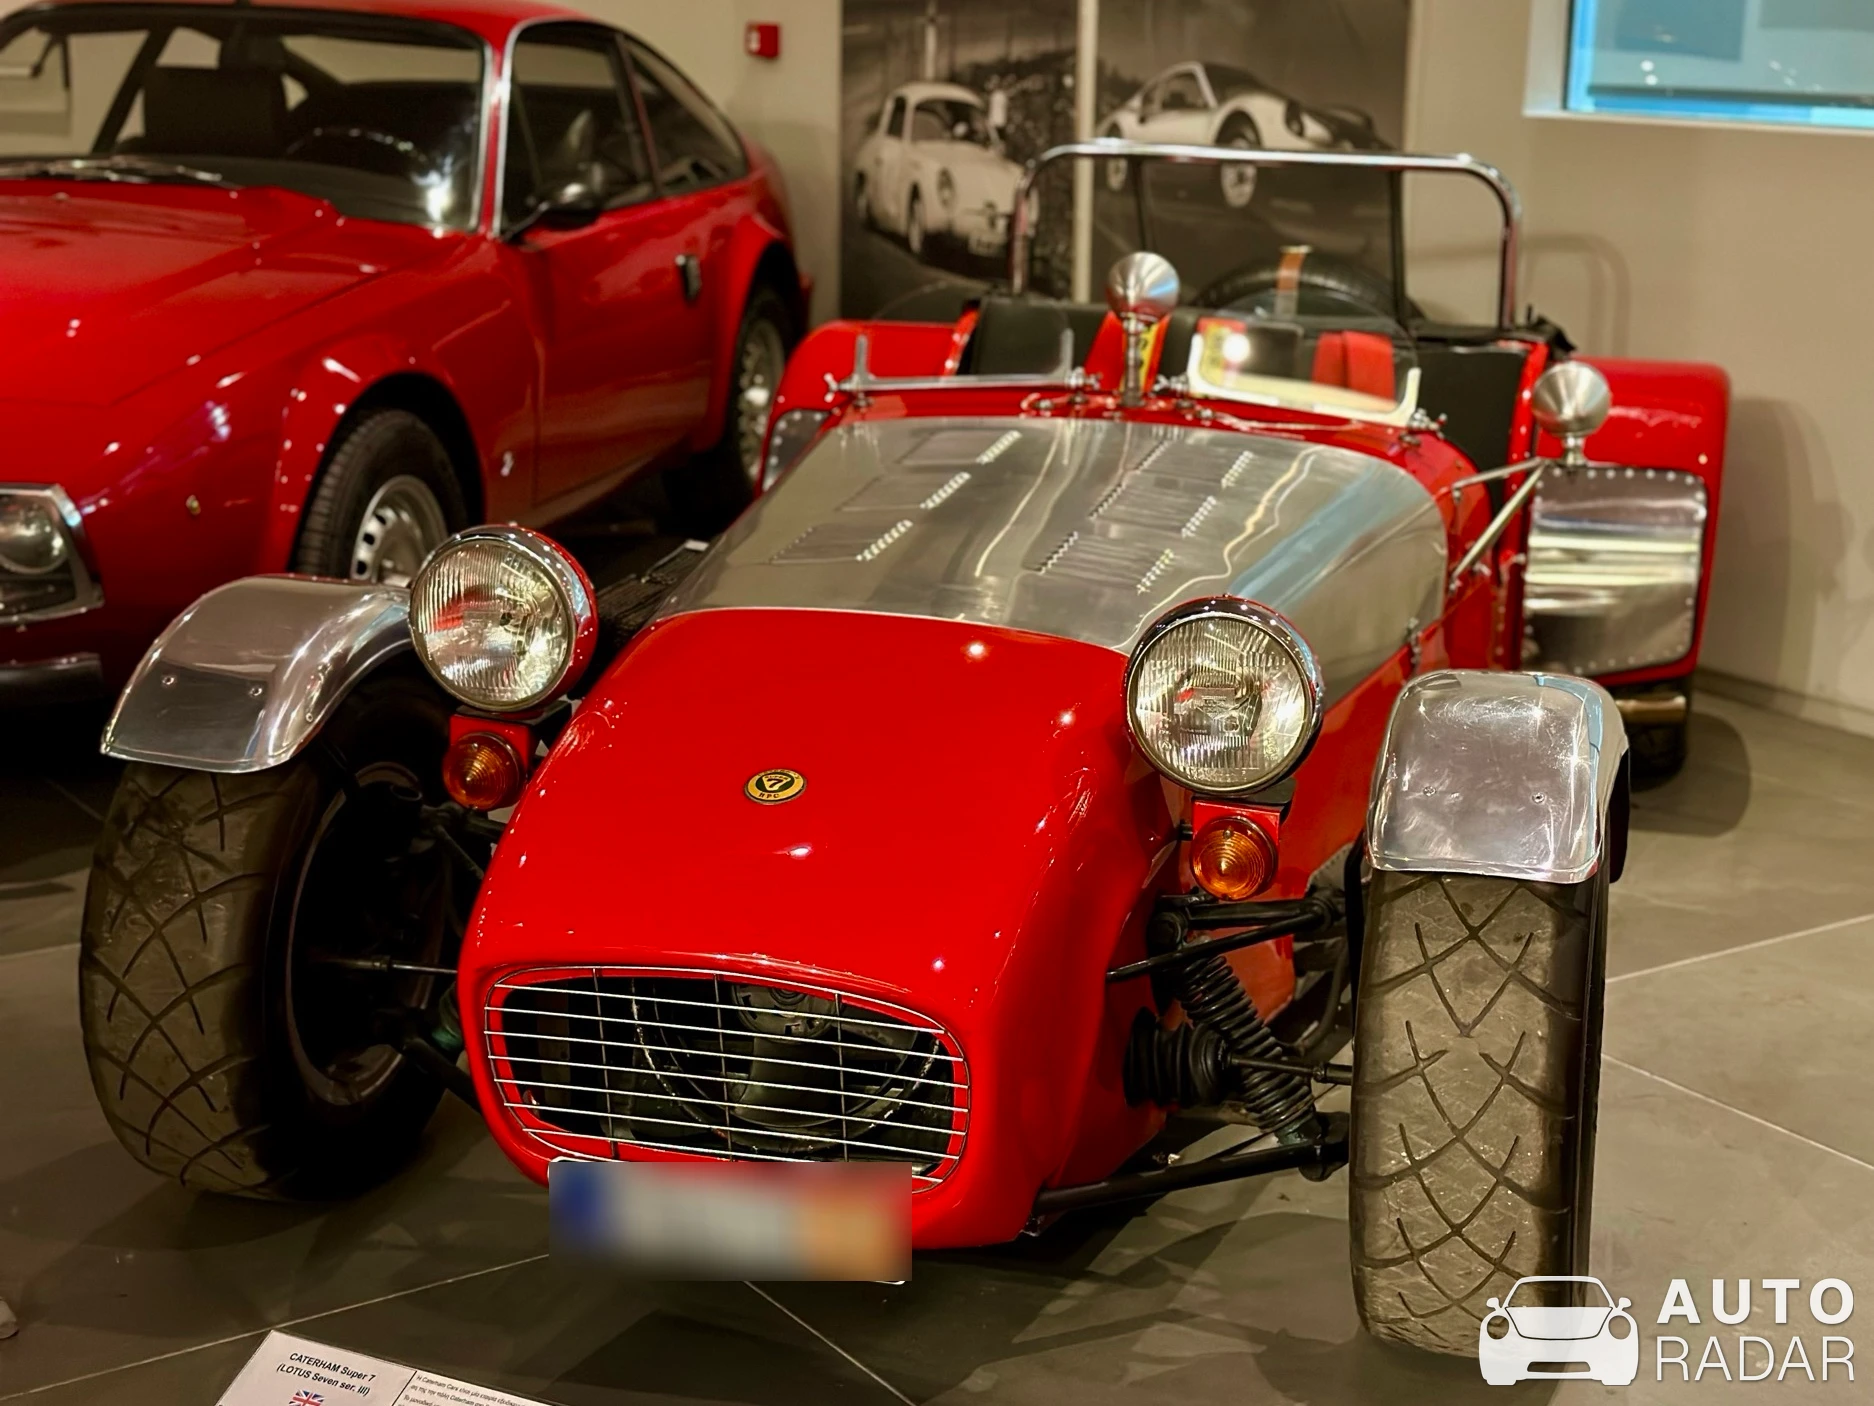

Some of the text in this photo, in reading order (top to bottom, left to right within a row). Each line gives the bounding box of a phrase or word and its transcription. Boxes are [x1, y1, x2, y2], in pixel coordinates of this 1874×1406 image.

[766, 778, 784, 788] 7
[276, 1363, 370, 1397] (LOTUS Seven ser. III)
[289, 1352, 376, 1382] CATERHAM Super 7
